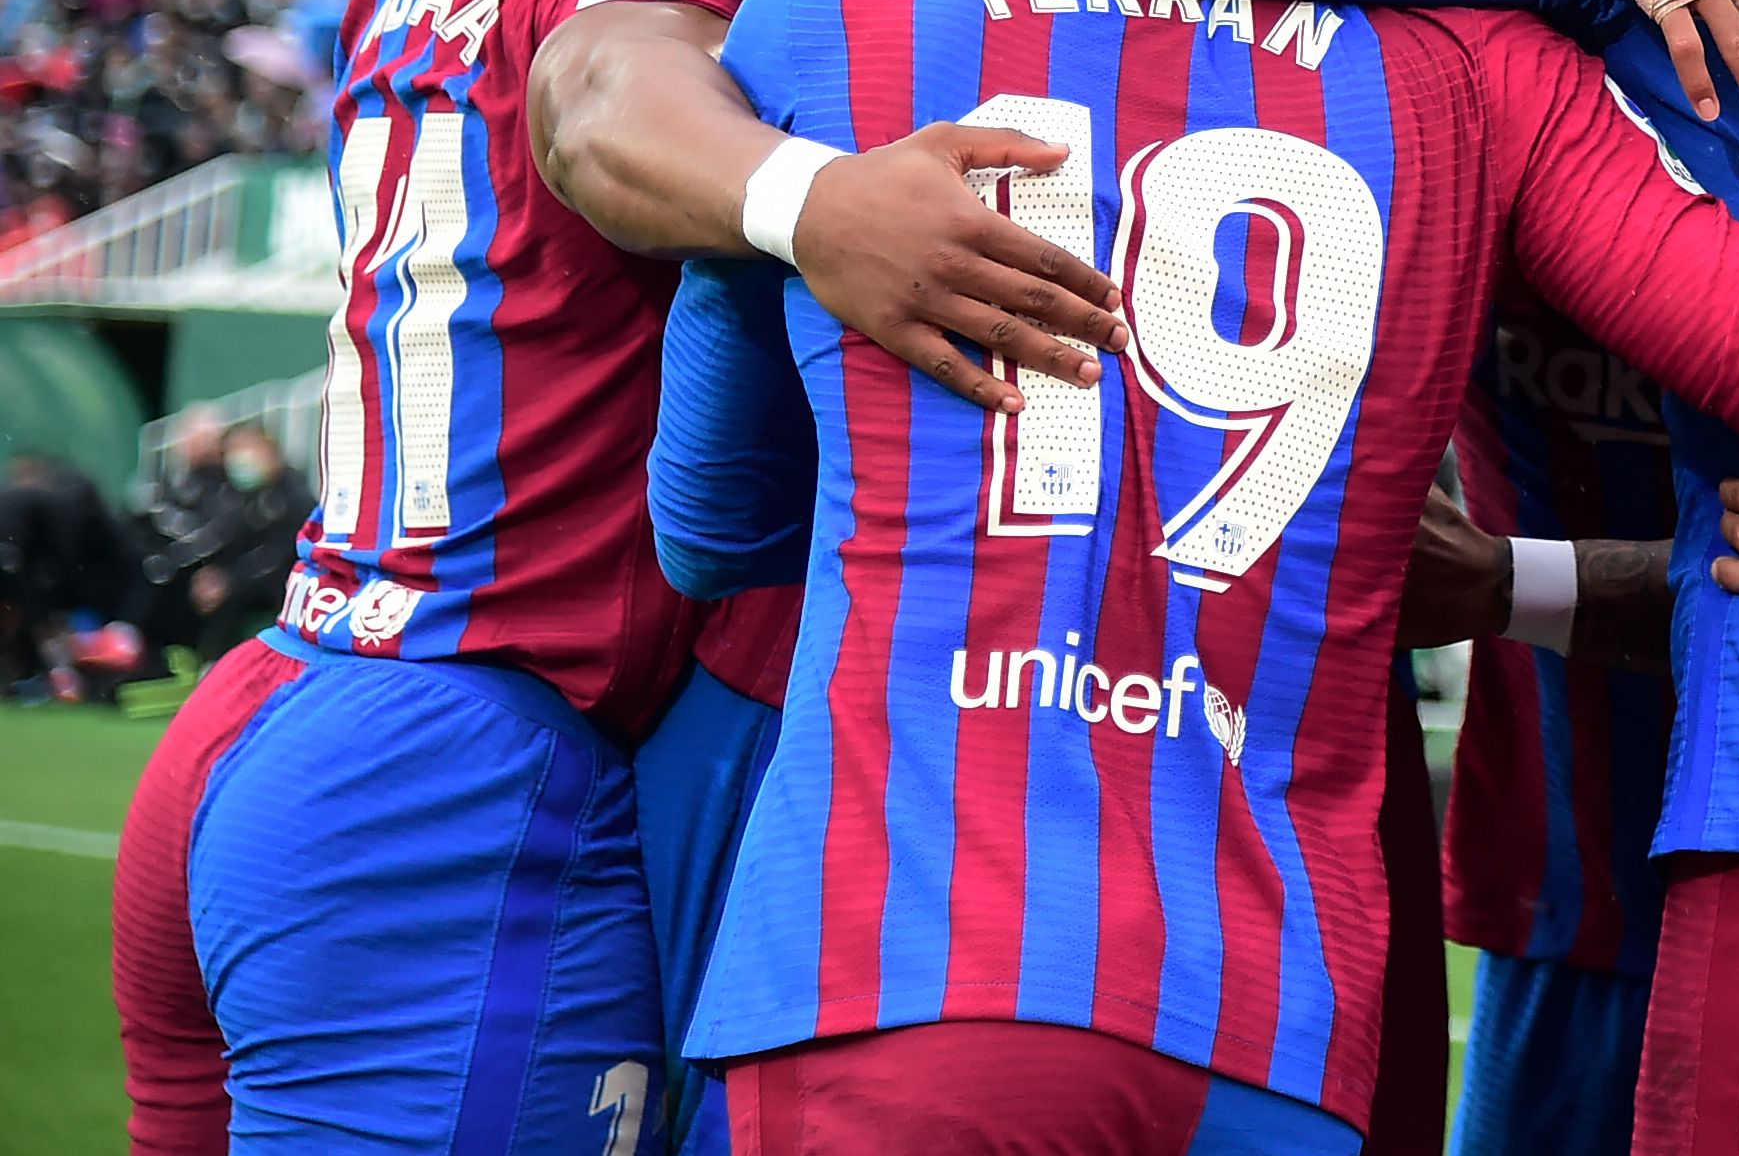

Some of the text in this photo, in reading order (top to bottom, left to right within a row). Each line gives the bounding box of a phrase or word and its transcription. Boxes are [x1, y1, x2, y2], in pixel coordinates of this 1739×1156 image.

[318, 113, 468, 550] 11
[955, 93, 1384, 594] 19
[1496, 325, 1662, 426] Rak
[949, 631, 1199, 739] unicef
